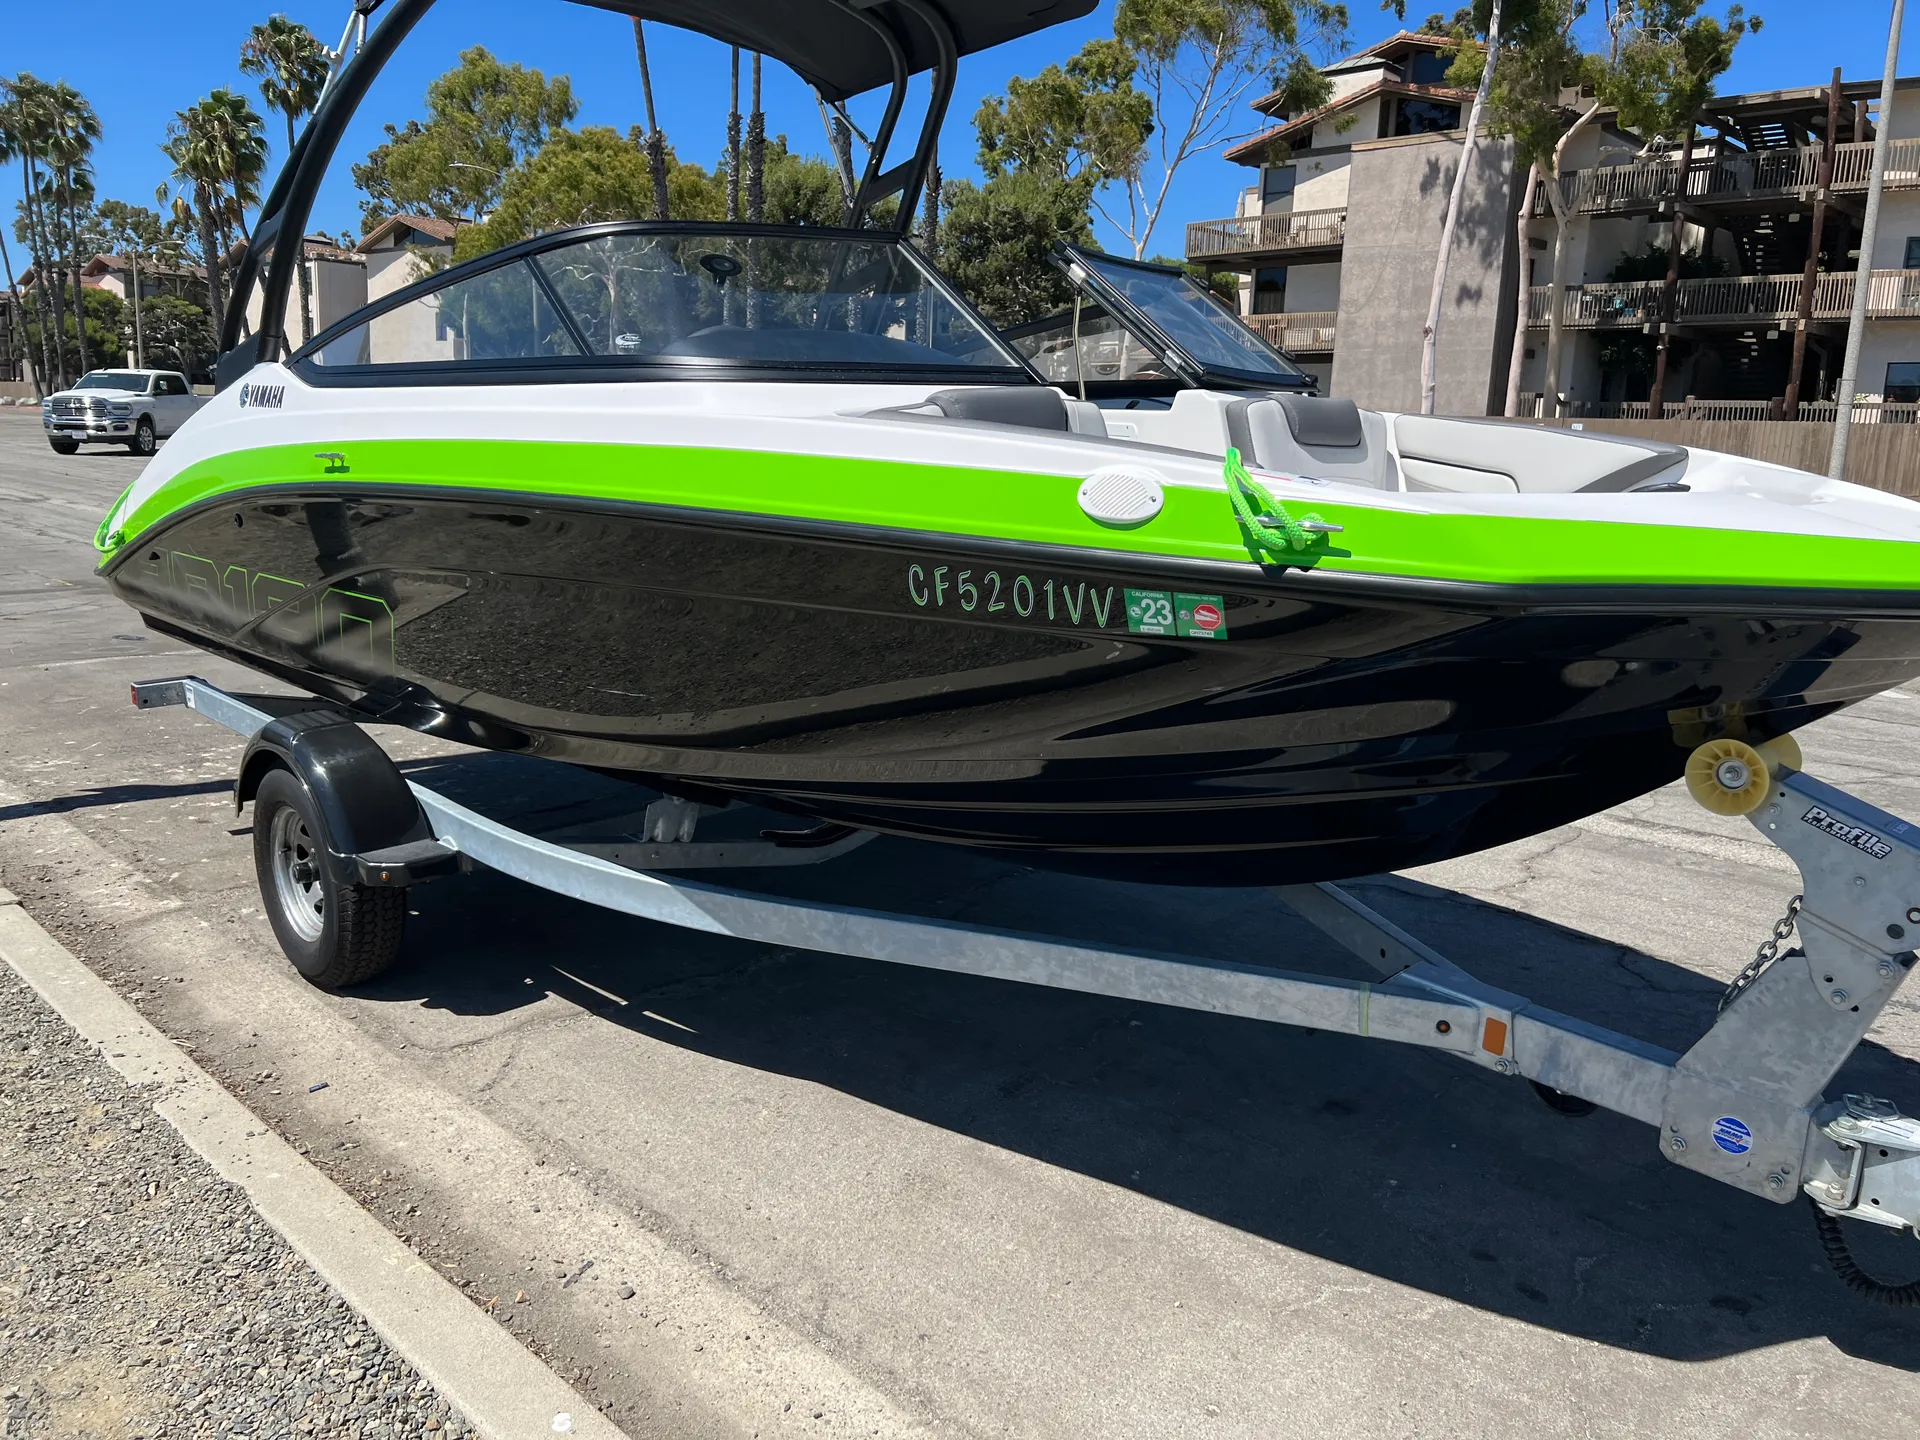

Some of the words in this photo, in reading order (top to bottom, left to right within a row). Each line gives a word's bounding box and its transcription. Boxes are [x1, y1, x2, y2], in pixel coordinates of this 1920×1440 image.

[249, 385, 285, 408] YAMAHA
[908, 563, 1113, 628] CF5201VV
[1140, 598, 1173, 625] 23
[1803, 817, 1856, 845] PERFORMANCE
[1857, 843, 1884, 858] WINCH
[1805, 806, 1892, 856] Profile
